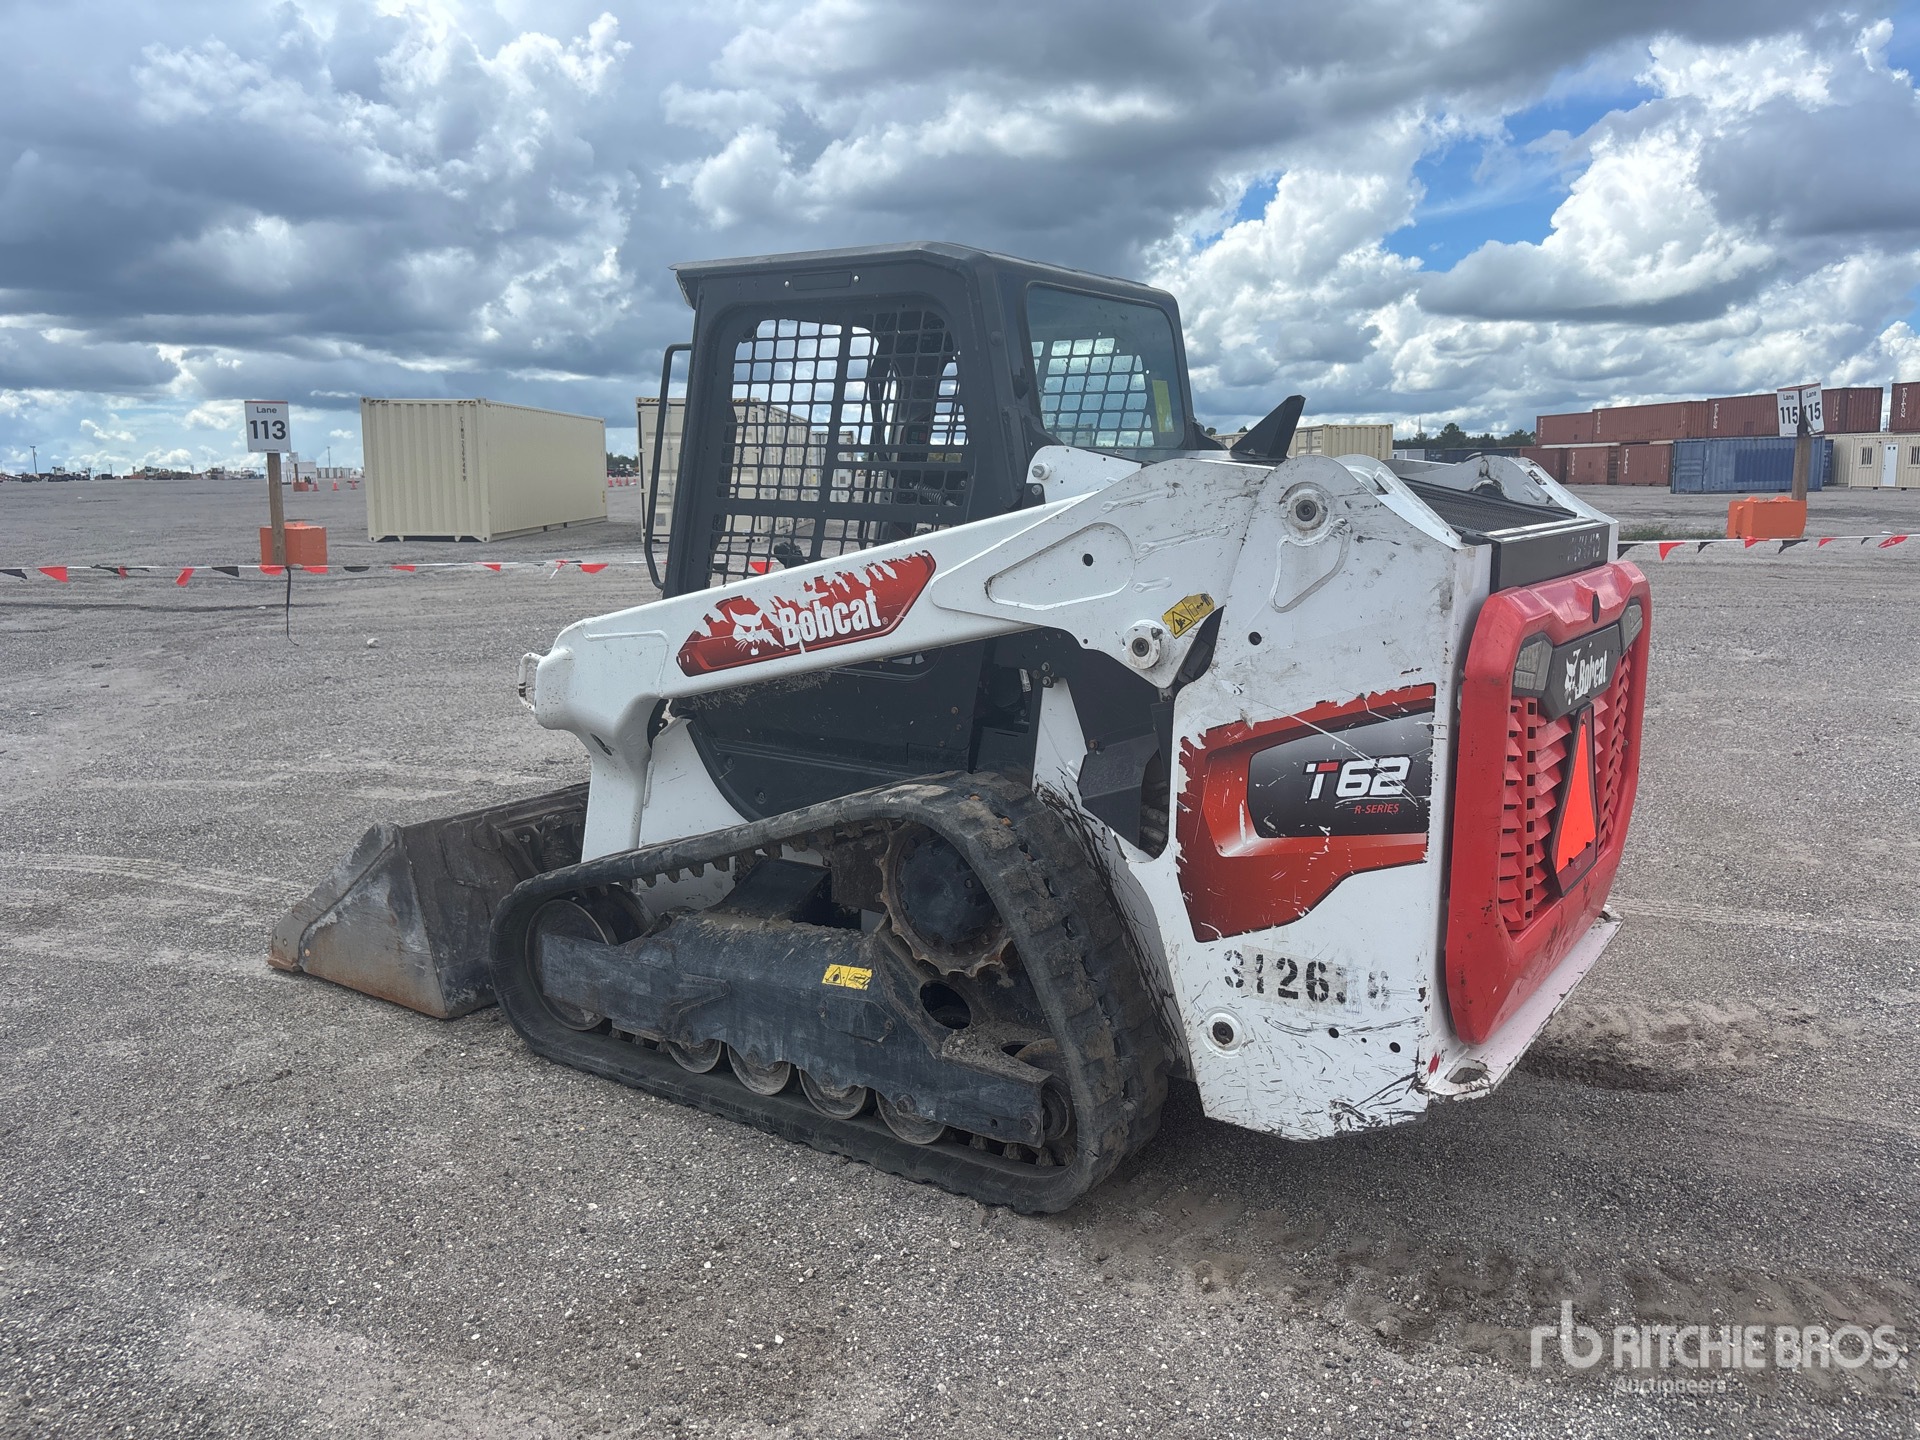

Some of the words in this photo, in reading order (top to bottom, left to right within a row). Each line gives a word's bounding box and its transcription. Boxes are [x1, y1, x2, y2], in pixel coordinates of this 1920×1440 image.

[1806, 391, 1817, 399] Lane
[1780, 406, 1798, 424] 115
[250, 420, 287, 440] 113
[778, 590, 882, 646] Bobcat
[1576, 650, 1607, 699] Bobcat
[1305, 756, 1411, 799] T62
[1354, 803, 1400, 815] R-SERIES
